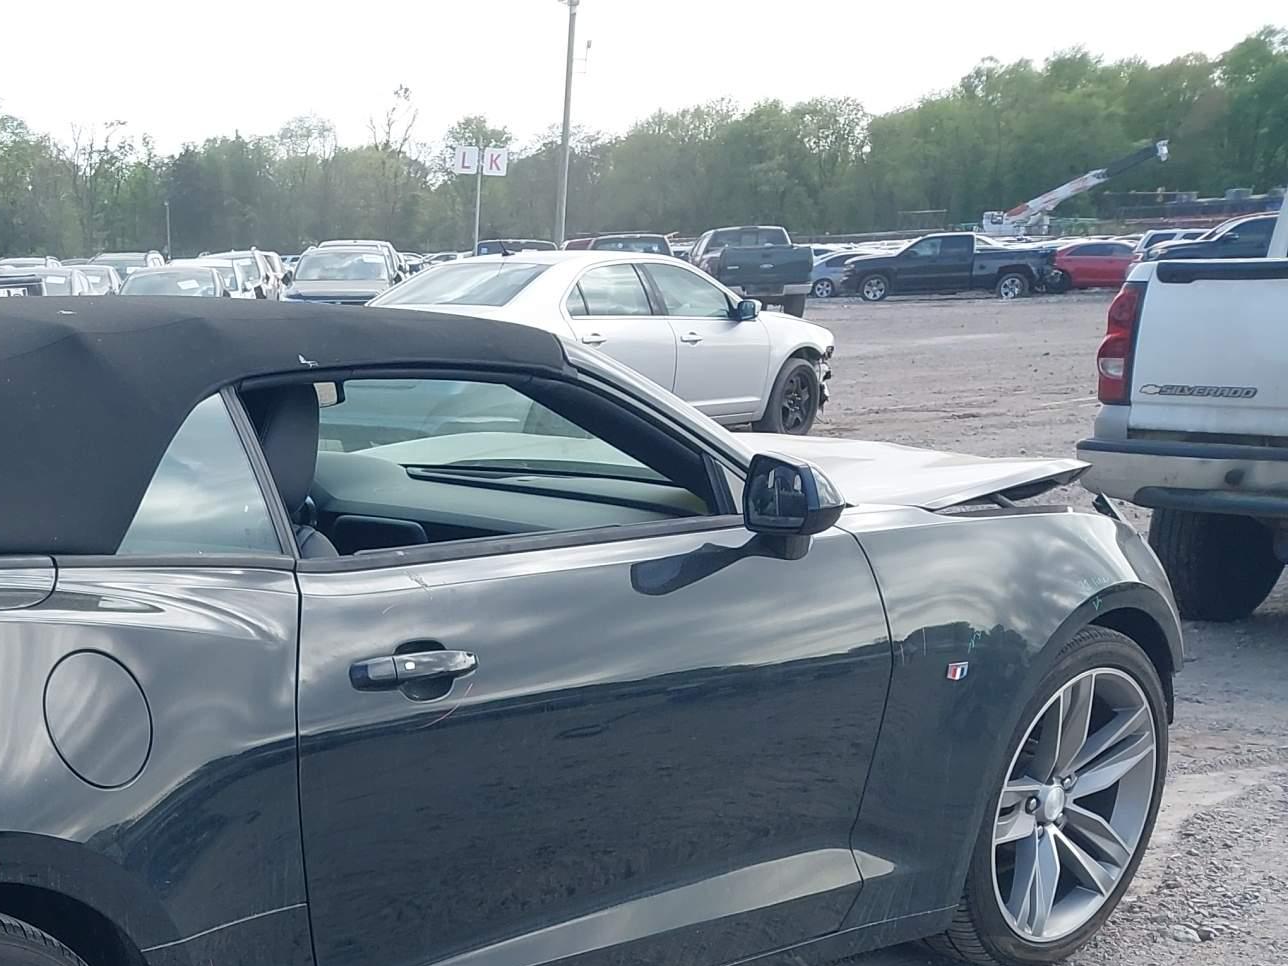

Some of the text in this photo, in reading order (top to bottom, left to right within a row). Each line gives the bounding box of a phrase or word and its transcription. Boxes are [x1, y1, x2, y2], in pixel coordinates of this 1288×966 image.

[461, 151, 471, 169] L
[489, 153, 501, 171] K
[1160, 385, 1257, 398] SILVERADO
